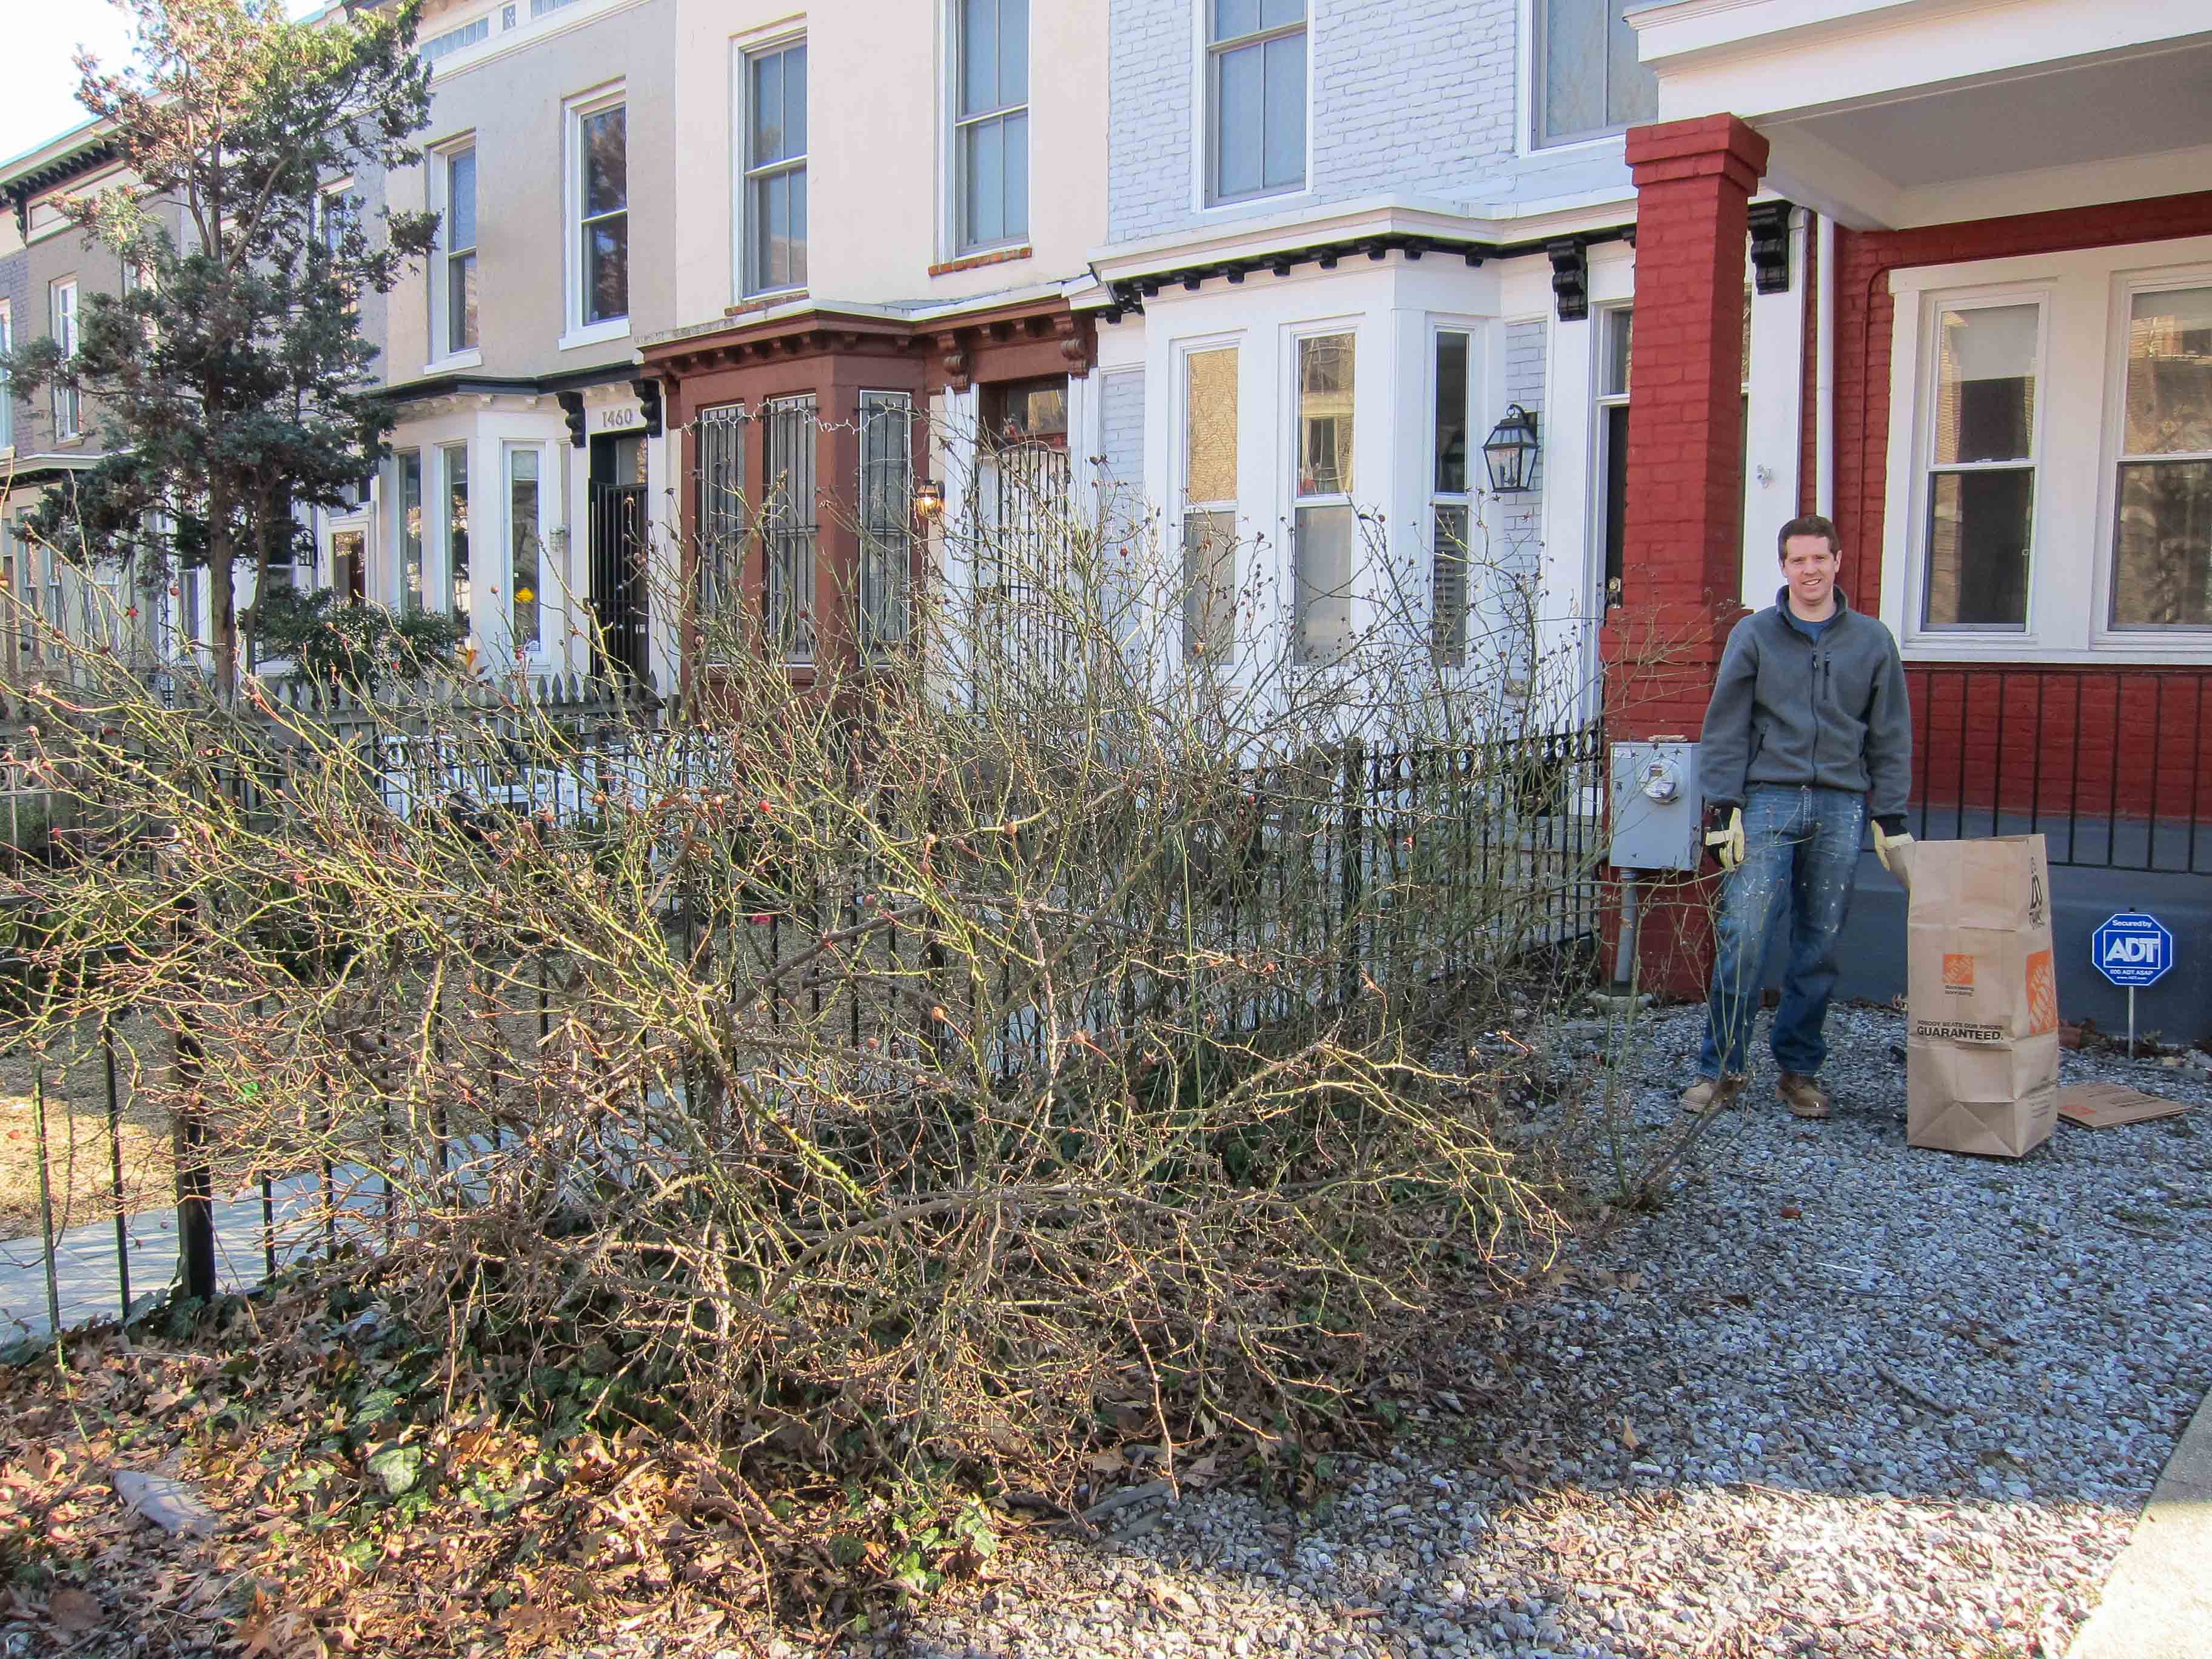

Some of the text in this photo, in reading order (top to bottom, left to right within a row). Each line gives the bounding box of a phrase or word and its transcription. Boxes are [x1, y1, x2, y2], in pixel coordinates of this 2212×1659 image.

[602, 408, 631, 427] 1460
[2105, 937, 2160, 962] ADT
[1917, 1026, 2004, 1040] GUARANTEED.
